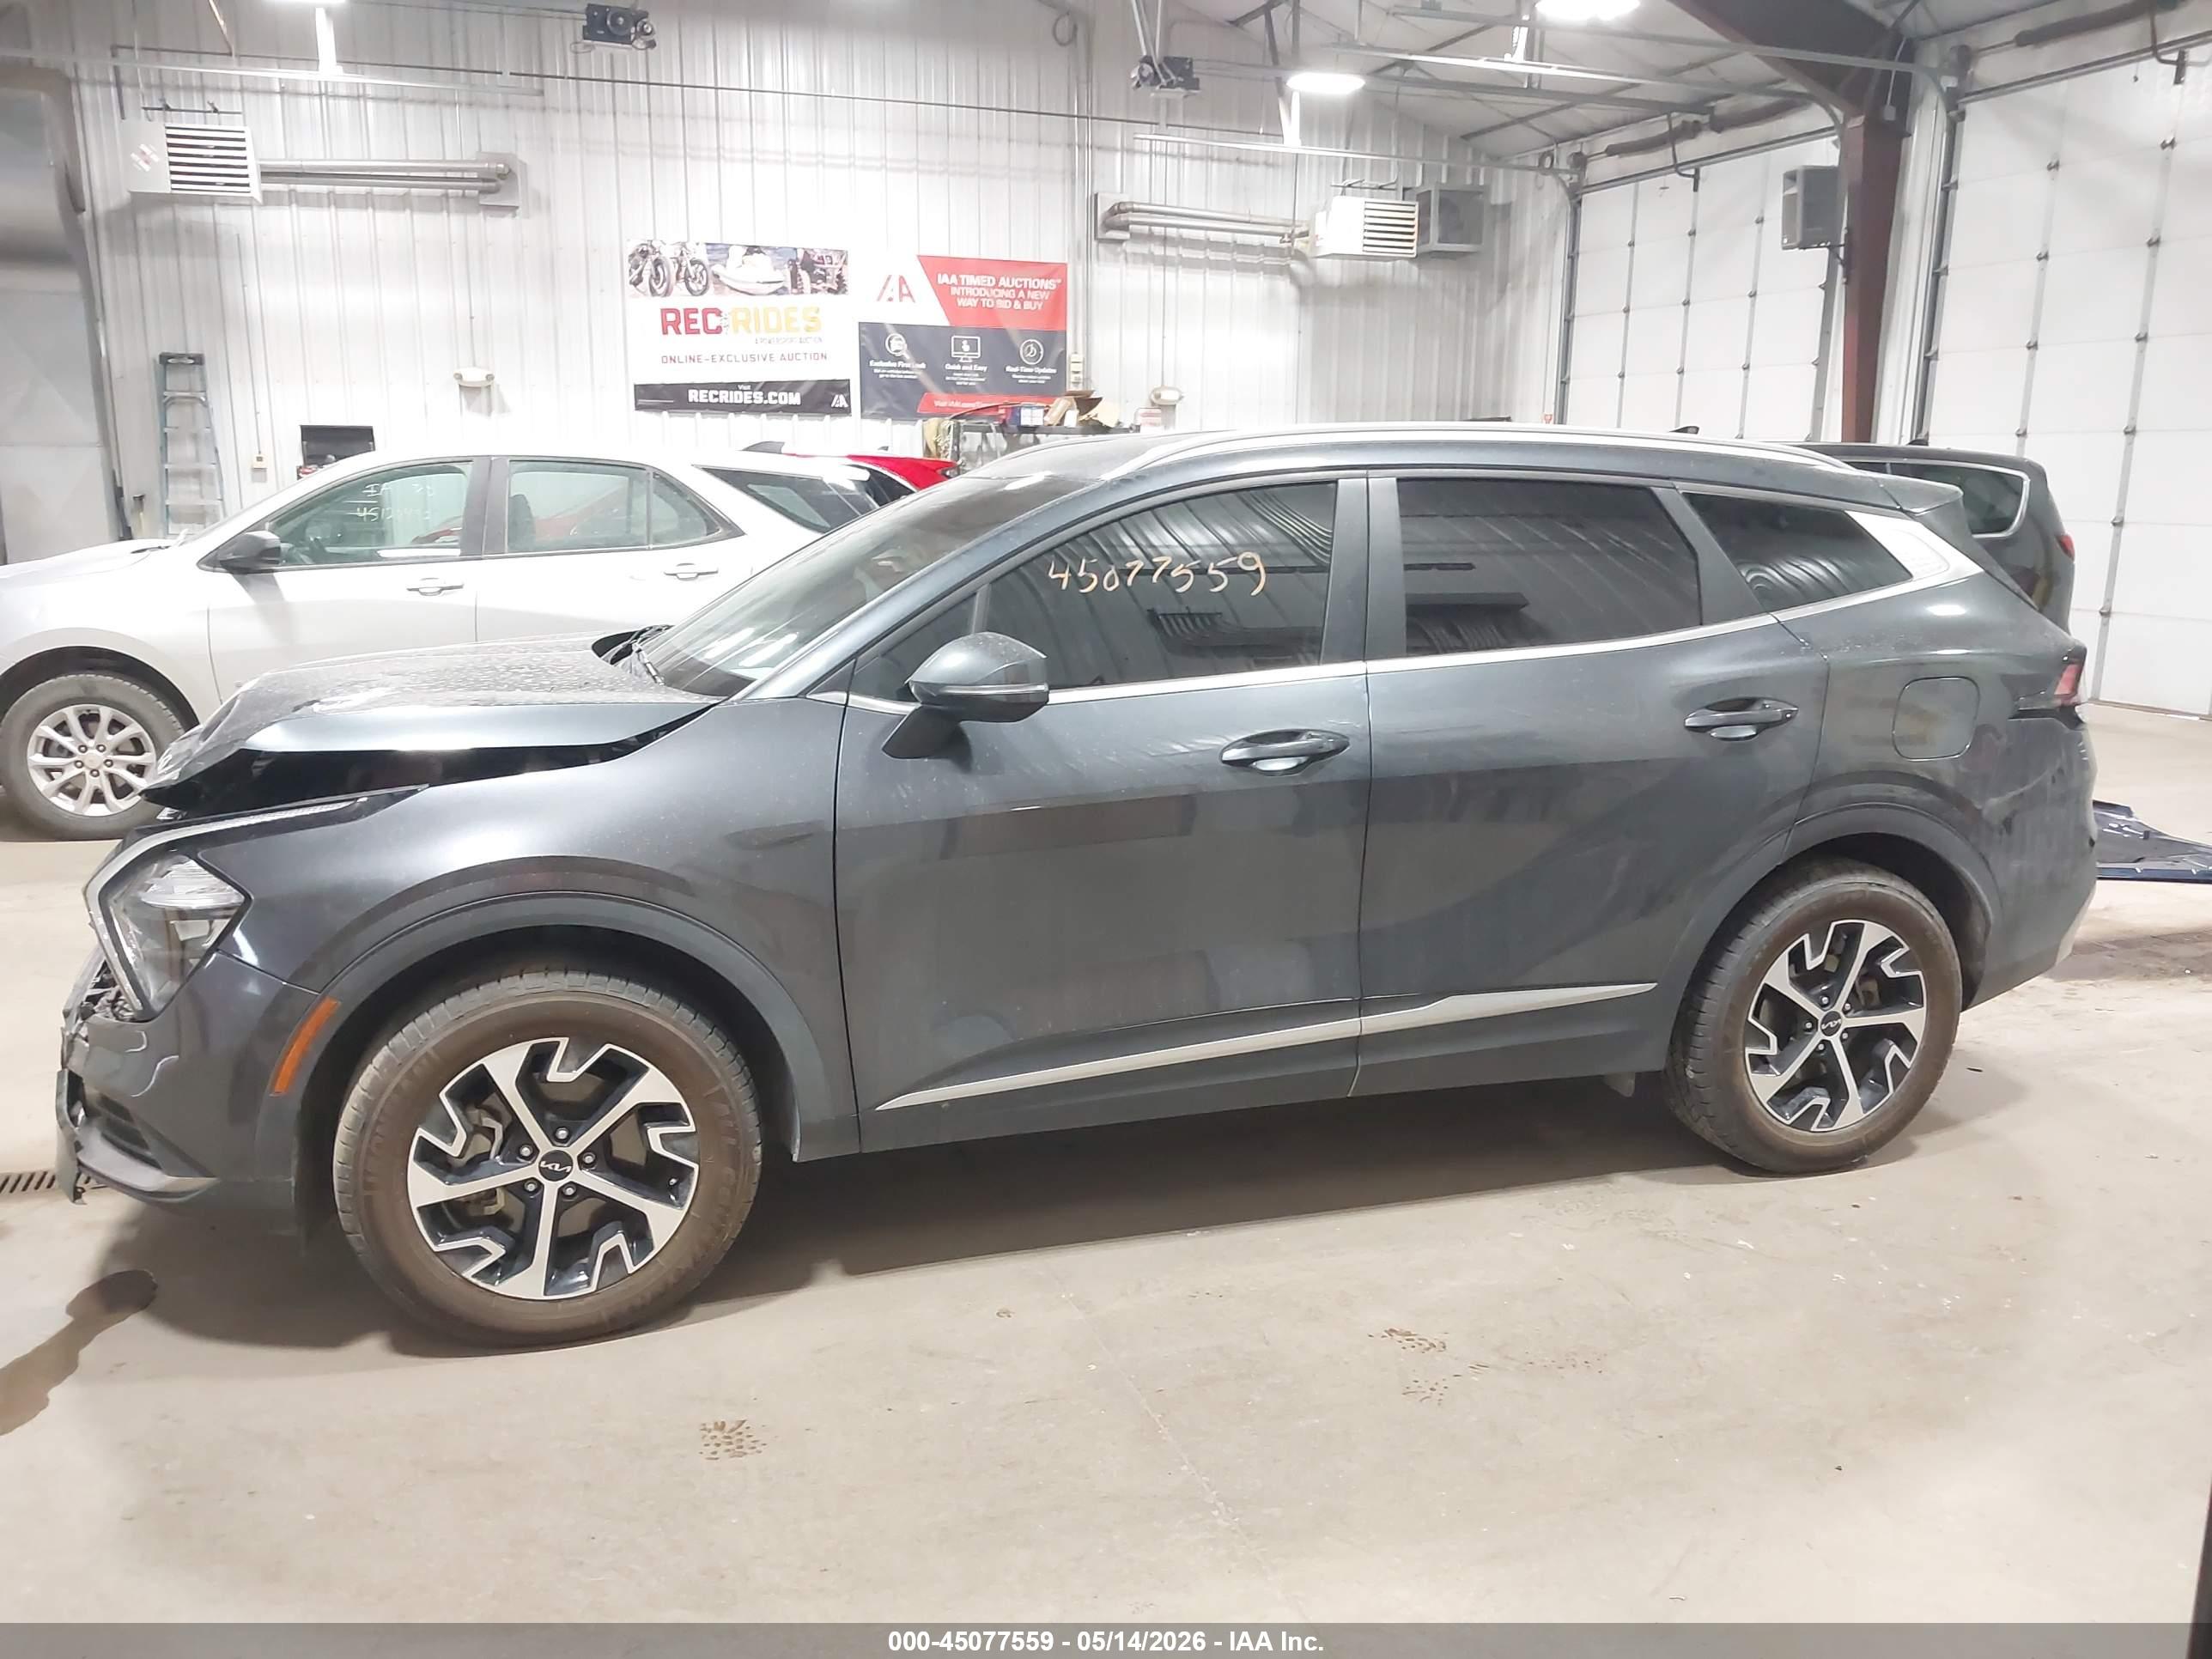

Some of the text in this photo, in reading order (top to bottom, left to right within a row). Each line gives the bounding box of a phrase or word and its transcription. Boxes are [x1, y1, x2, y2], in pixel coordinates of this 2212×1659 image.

[937, 273, 957, 285] IAA
[959, 274, 995, 287] TIMED
[951, 286, 1050, 300] INTRODUCING A NEW
[957, 297, 1044, 310] WAY TO BID & BUY
[660, 307, 822, 335] REC RIDES
[661, 352, 828, 364] ONLINE-EXCLUSIVE AUCTION
[688, 389, 801, 405] RECRIDES.COM
[1048, 551, 1267, 596] 45077559
